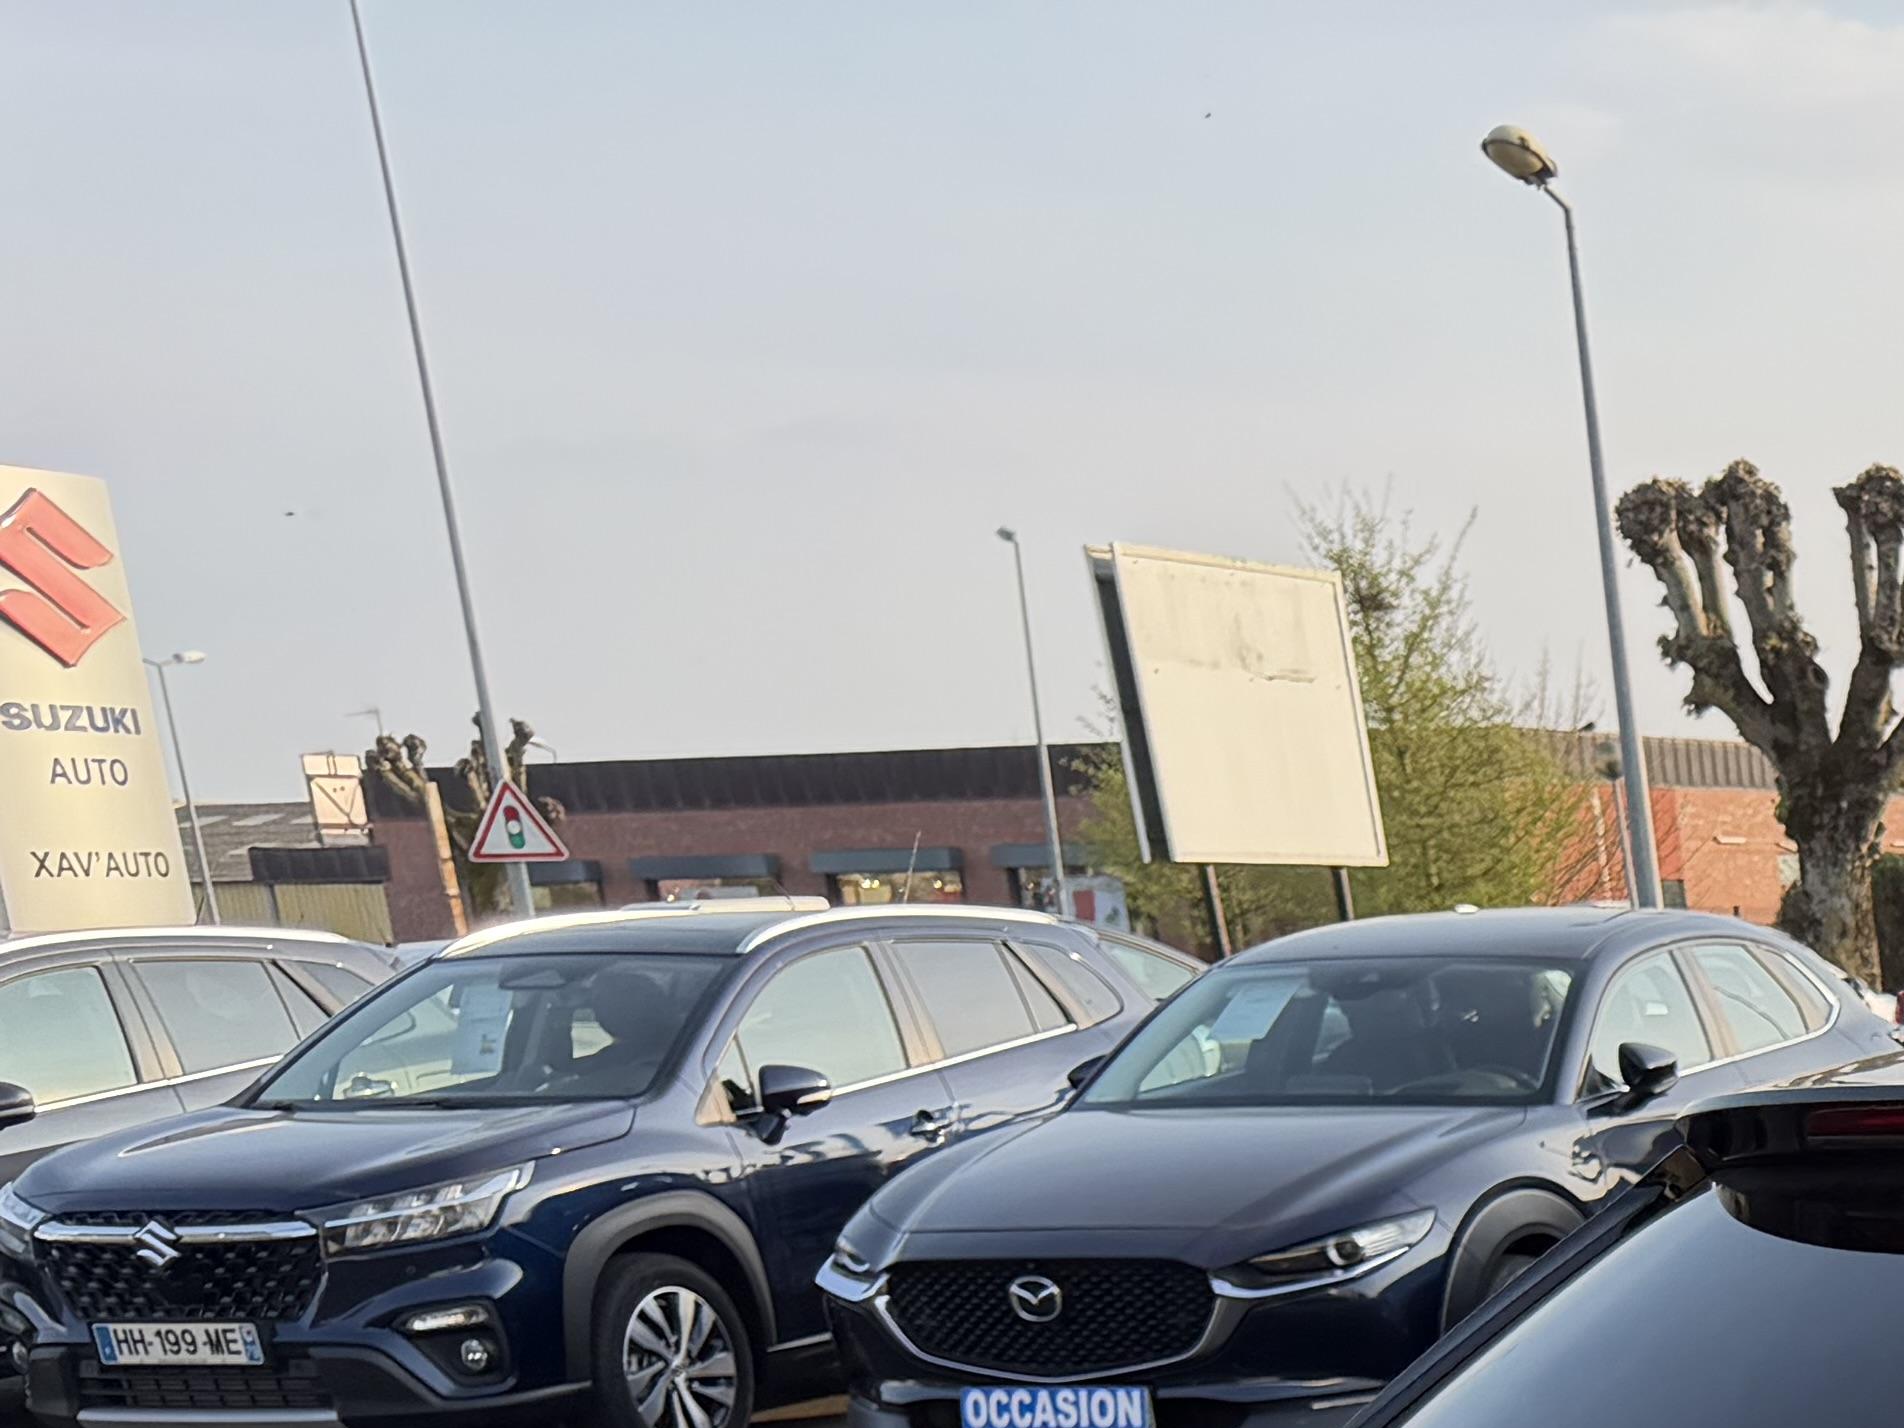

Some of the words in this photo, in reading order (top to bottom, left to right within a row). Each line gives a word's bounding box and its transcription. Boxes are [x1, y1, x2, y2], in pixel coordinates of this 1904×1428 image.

[0, 702, 142, 735] SUZUKI
[50, 757, 129, 786] AUTO
[30, 850, 170, 878] XAV'AUTO
